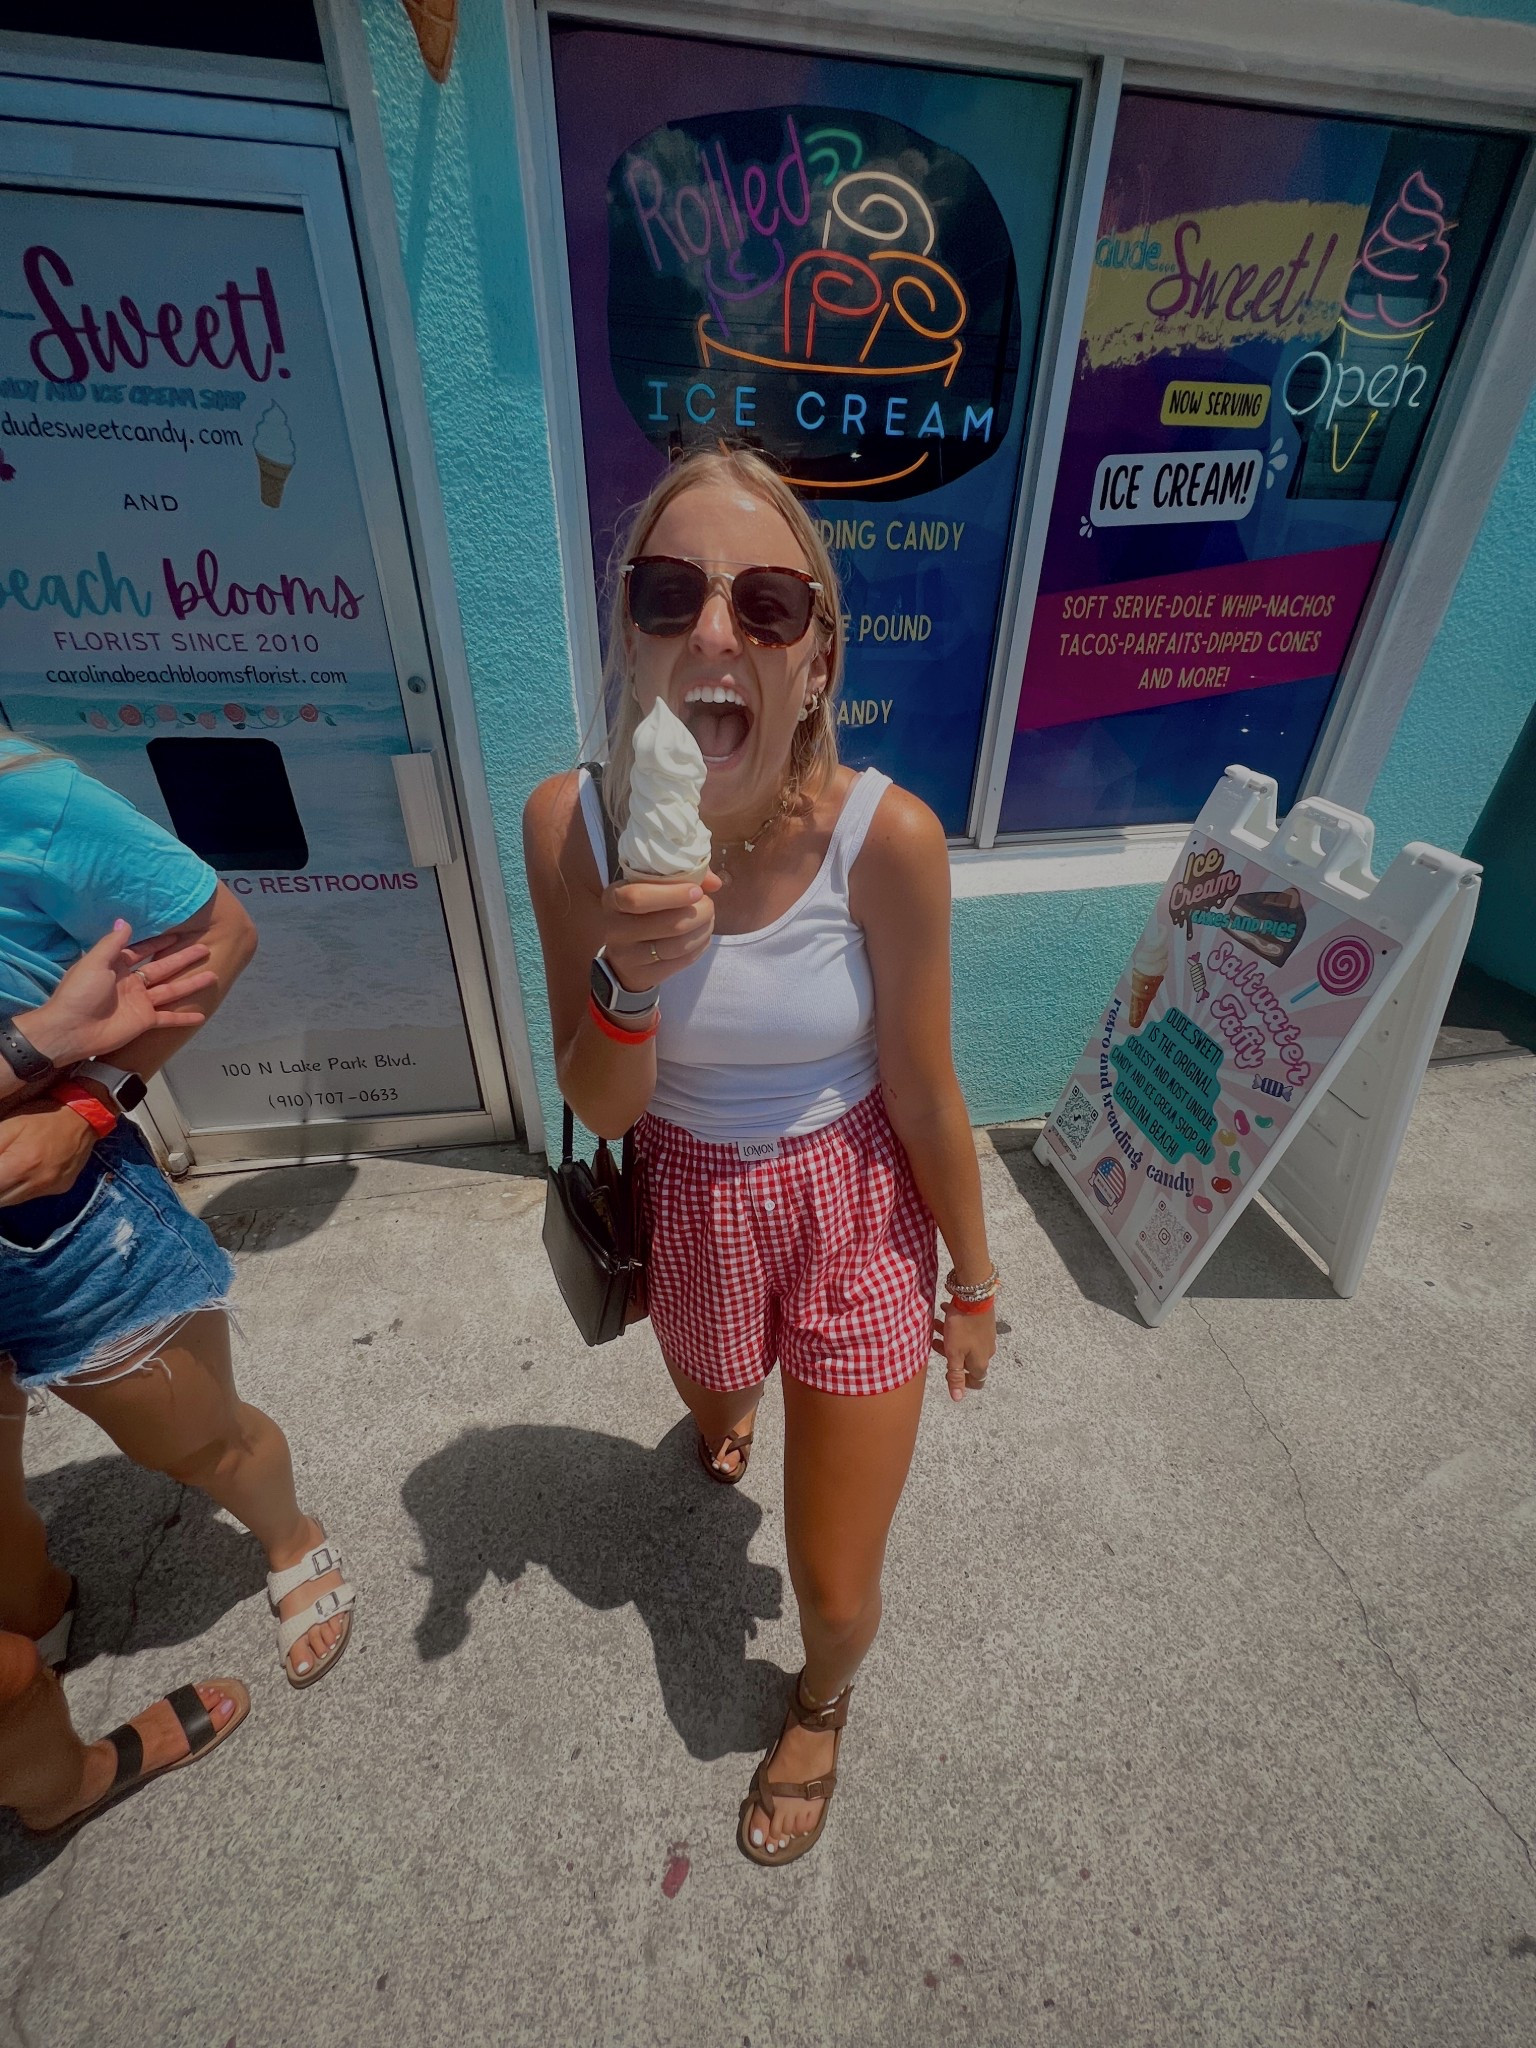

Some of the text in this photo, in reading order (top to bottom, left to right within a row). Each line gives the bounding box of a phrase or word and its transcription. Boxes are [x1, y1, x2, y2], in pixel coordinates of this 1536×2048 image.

[626, 113, 810, 271] Rolled
[1146, 220, 1339, 328] Sweet!
[23, 245, 291, 383] Sweet!
[1168, 389, 1263, 417] NOW SERVING
[1282, 350, 1428, 431] Open
[647, 380, 994, 443] ICE CREAM
[2, 411, 243, 453] dudesweetcandy.com
[123, 493, 179, 512] AND
[1099, 459, 1256, 511] ICE CREAM!
[814, 519, 965, 552] DING CANDY
[0, 548, 365, 621] each blooms
[1062, 594, 1336, 620] SOFT SERVE-DOLE WHIP-NACHOS
[53, 631, 320, 654] FLORIST SINCE 2010
[858, 614, 932, 642] POUND
[1267, 630, 1322, 653] CONES
[46, 664, 347, 686] carolinabeachbloomsflorist.com
[1137, 666, 1231, 690] AND MORE!
[836, 699, 894, 725] ANDY
[259, 872, 419, 894] RESTROOMS
[1183, 848, 1224, 884] Ice
[1170, 870, 1241, 911] Cream
[1231, 916, 1260, 933] AND
[1101, 998, 1122, 1049] retro
[1166, 1008, 1192, 1039] DUDE
[1207, 941, 1311, 1086] Saltwater
[1210, 993, 1267, 1069] Taffy
[221, 1052, 417, 1077] 100 N Lake Park Blvd.
[1100, 1053, 1112, 1089] and
[1148, 1025, 1213, 1098] IS THE ORIGINAL
[268, 1087, 399, 1110] (910)707-0633
[1127, 1036, 1217, 1132] COOLEST AND MOST UNIQUE
[1111, 1047, 1211, 1158] CANDY AND ICE CREAM SHOP ON
[1115, 1081, 1151, 1128] CAROLINA
[1102, 1092, 1143, 1170] trending
[1146, 1164, 1195, 1197] candy
